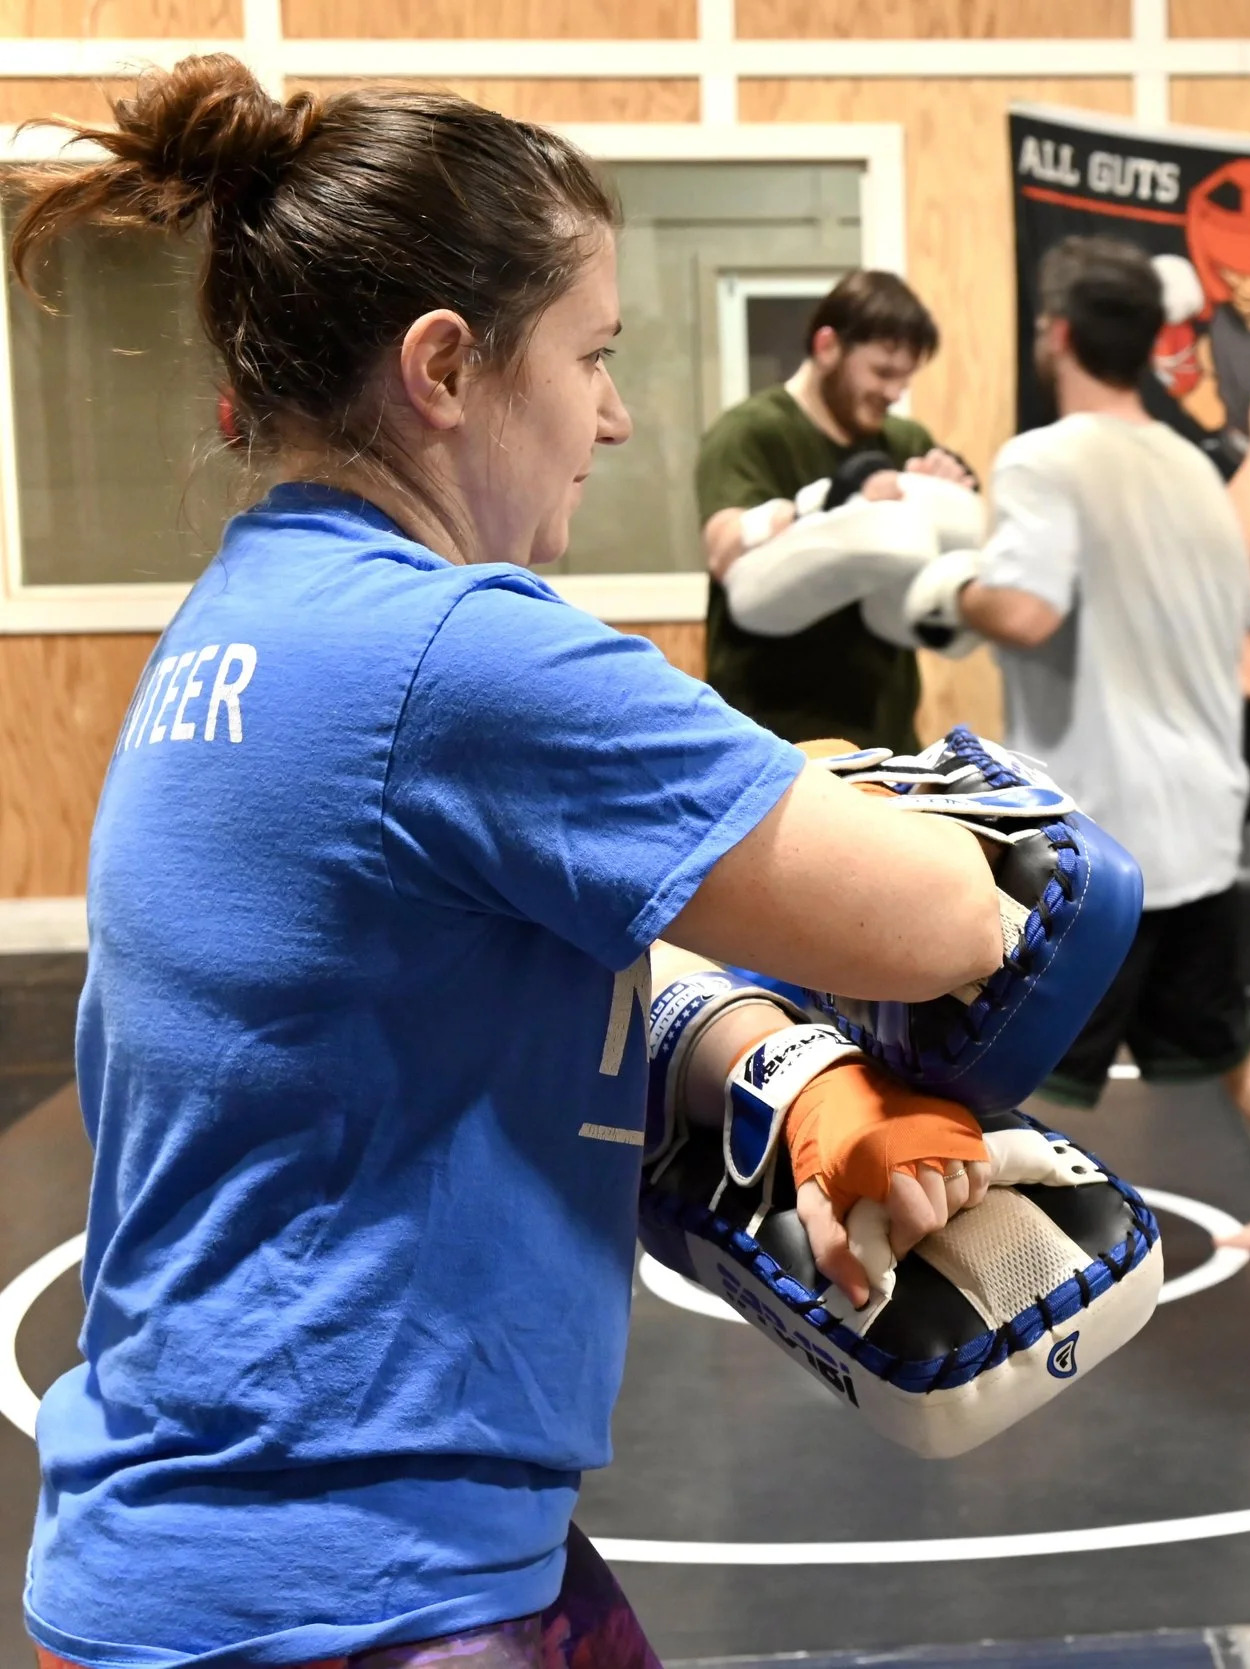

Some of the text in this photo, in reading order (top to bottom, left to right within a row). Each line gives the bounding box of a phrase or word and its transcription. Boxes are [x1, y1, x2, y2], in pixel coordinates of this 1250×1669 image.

[1019, 135, 1081, 188] ALL
[1087, 150, 1181, 204] GUTS
[649, 988, 697, 1054] UALITY
